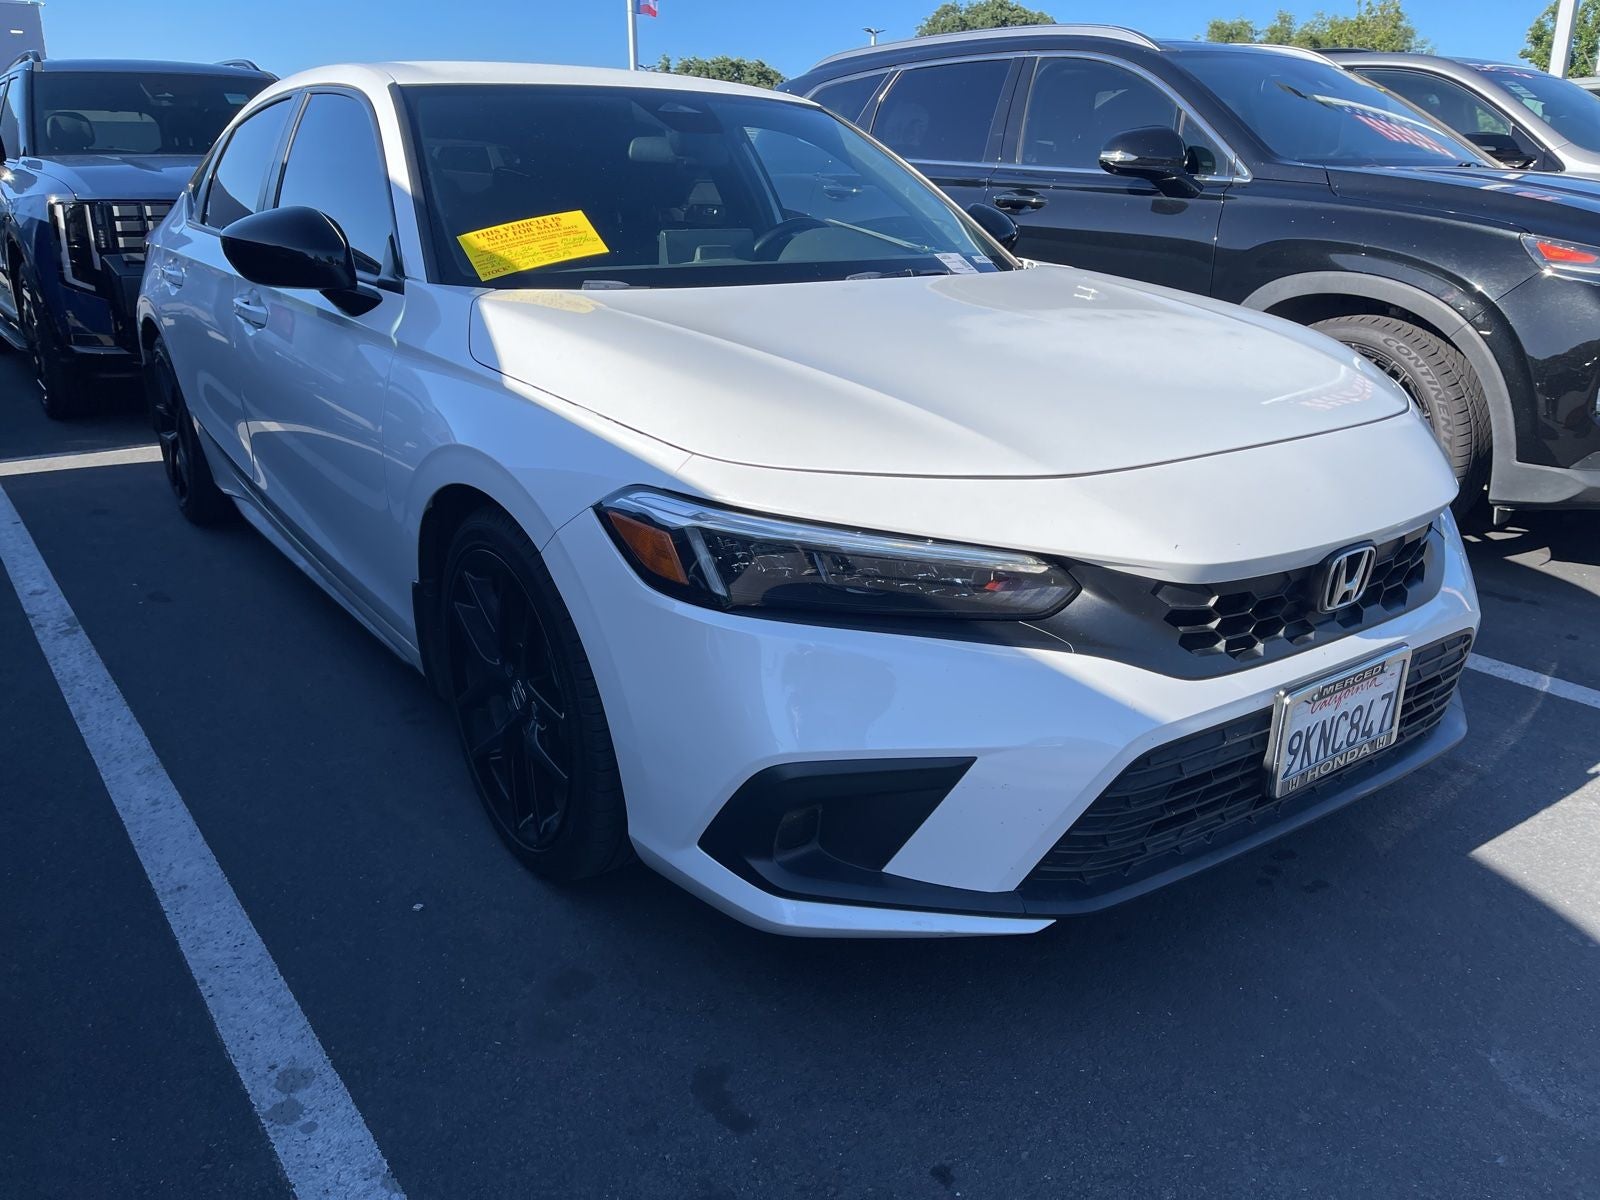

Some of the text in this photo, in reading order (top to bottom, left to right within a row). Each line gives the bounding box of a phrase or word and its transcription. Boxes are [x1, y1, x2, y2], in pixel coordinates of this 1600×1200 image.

[474, 215, 562, 240] THIS VEHICLE IS
[487, 221, 562, 242] NOT FOR SALE
[1322, 665, 1383, 695] MERCED
[1282, 691, 1395, 779] 9KNC847
[1306, 743, 1370, 782] HONDA
